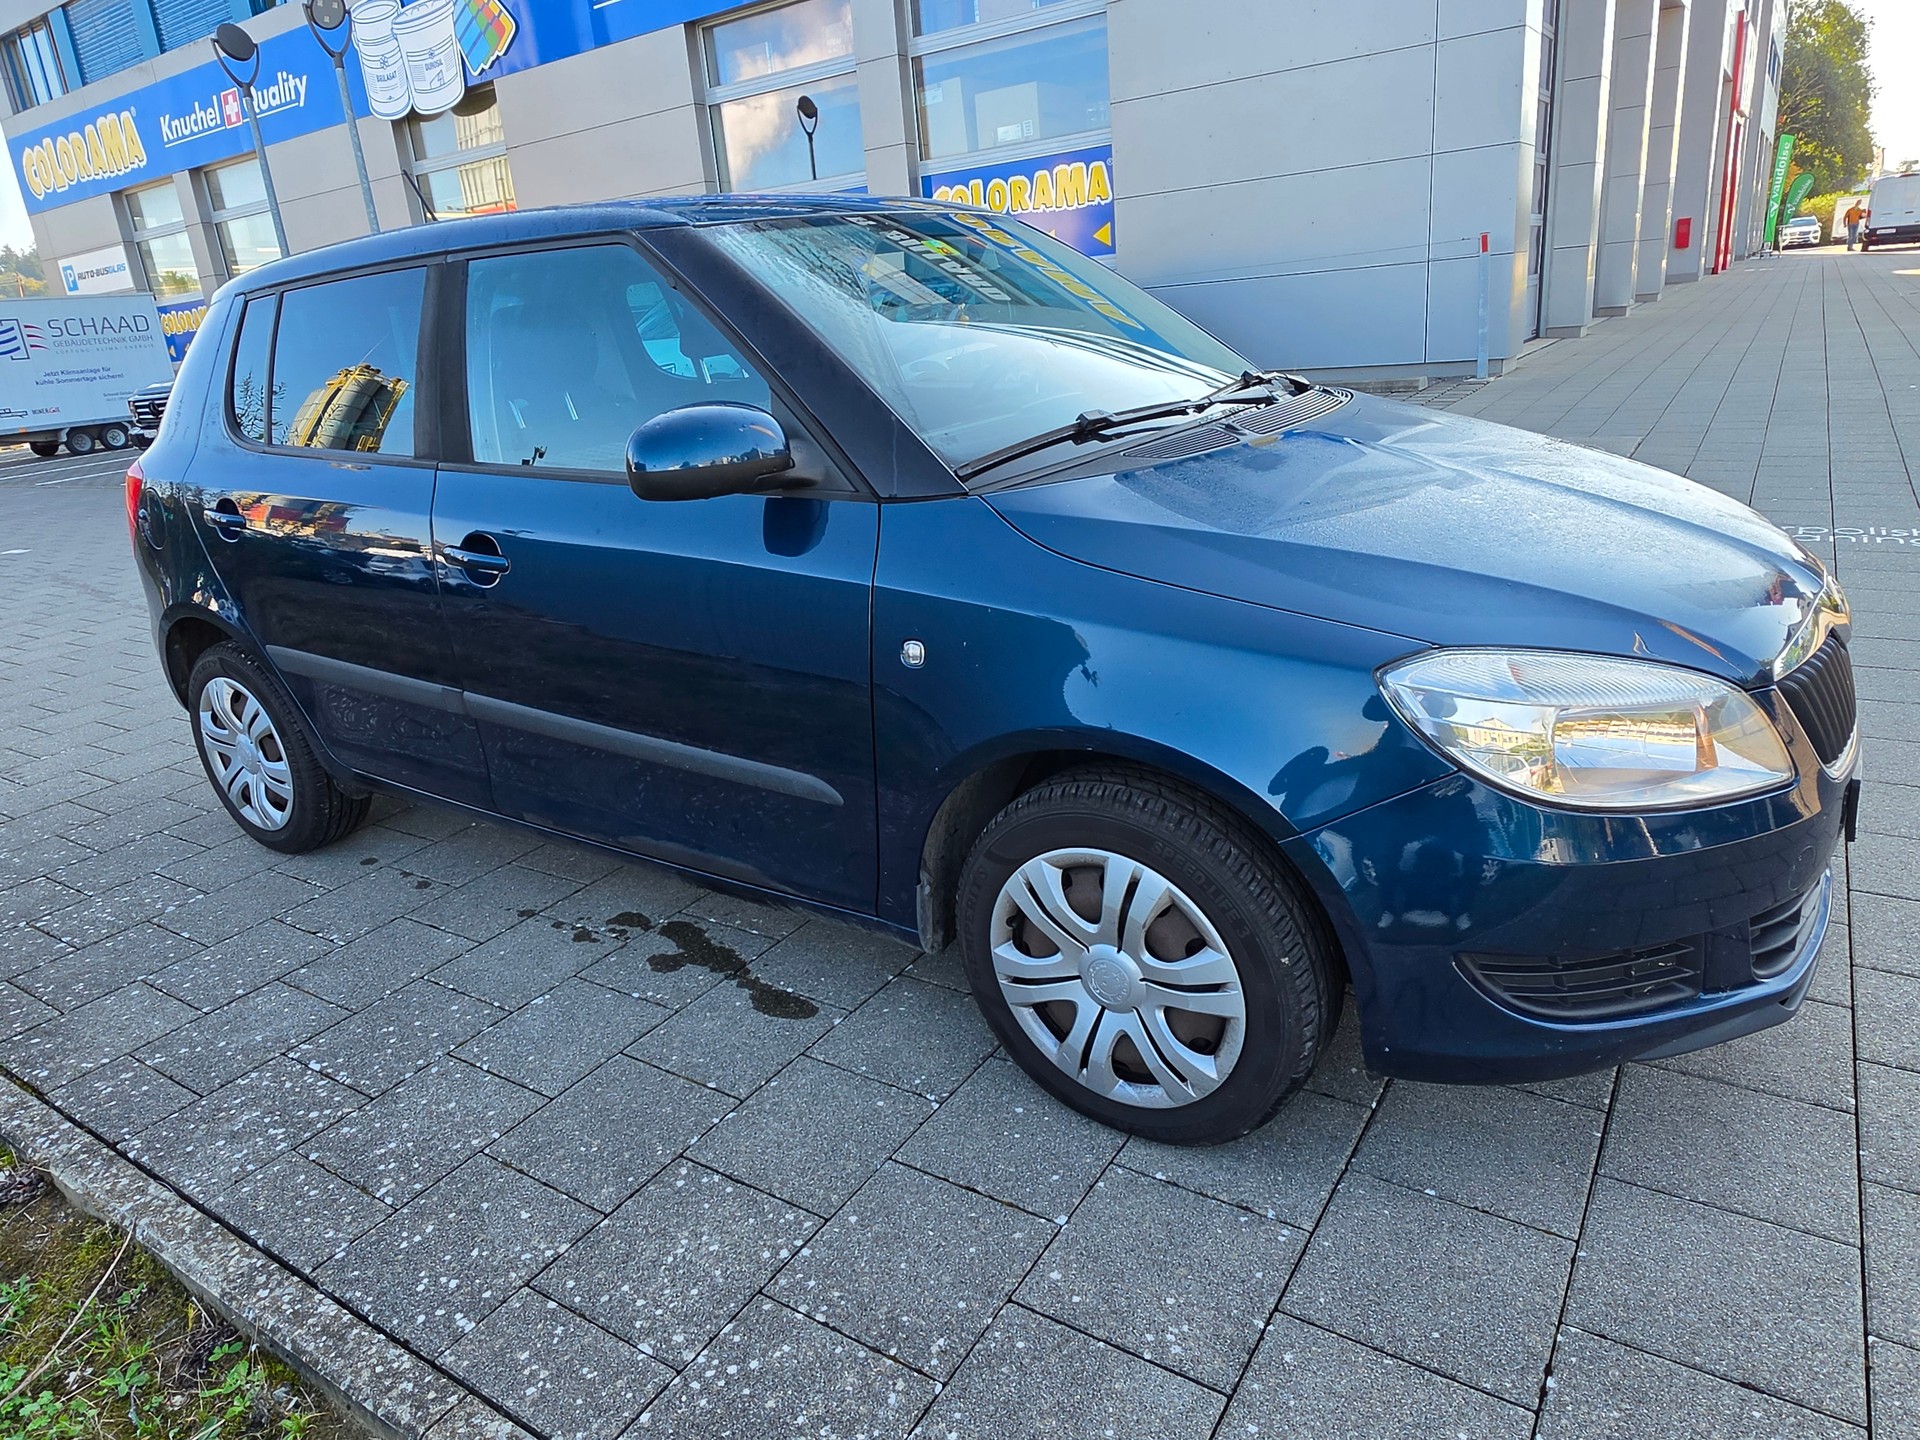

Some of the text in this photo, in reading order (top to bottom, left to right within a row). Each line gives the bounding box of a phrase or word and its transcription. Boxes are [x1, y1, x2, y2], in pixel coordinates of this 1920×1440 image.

[160, 95, 221, 142] Knuchel
[23, 110, 146, 200] COLORAMA
[1772, 142, 1790, 199] vaudoise
[77, 262, 126, 281] AUTO-BUSGLAS
[47, 314, 150, 338] SCHAAD
[43, 365, 111, 378] Jetzt Klimaanlage für
[55, 375, 98, 385] Sommertage
